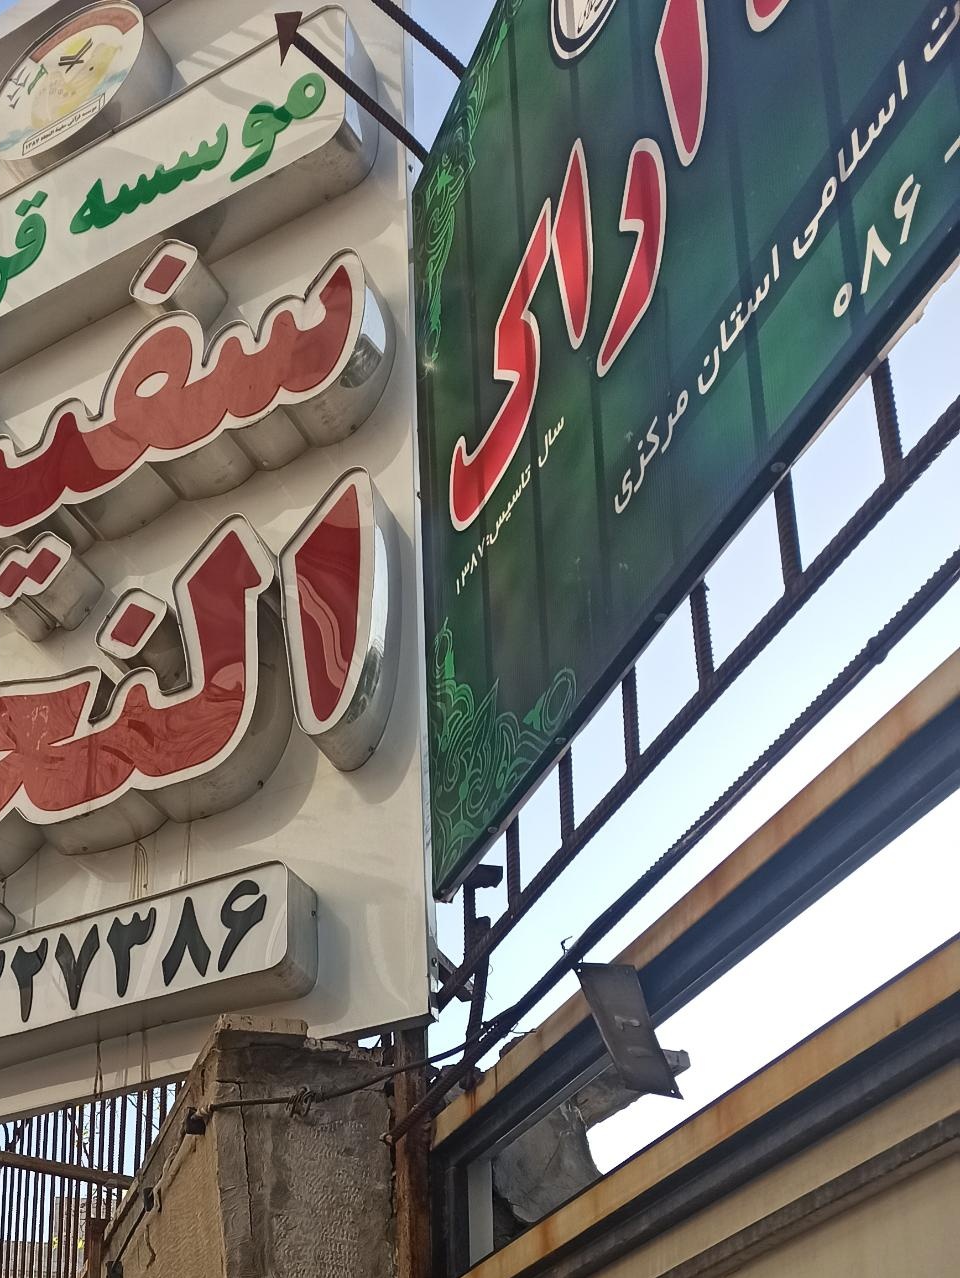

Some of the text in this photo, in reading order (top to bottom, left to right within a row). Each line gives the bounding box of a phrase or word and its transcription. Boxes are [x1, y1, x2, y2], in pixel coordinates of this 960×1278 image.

[69, 72, 326, 234] موسسه
[614, 60, 908, 514] اسلامی استان مرکزی
[538, 416, 565, 468] سال
